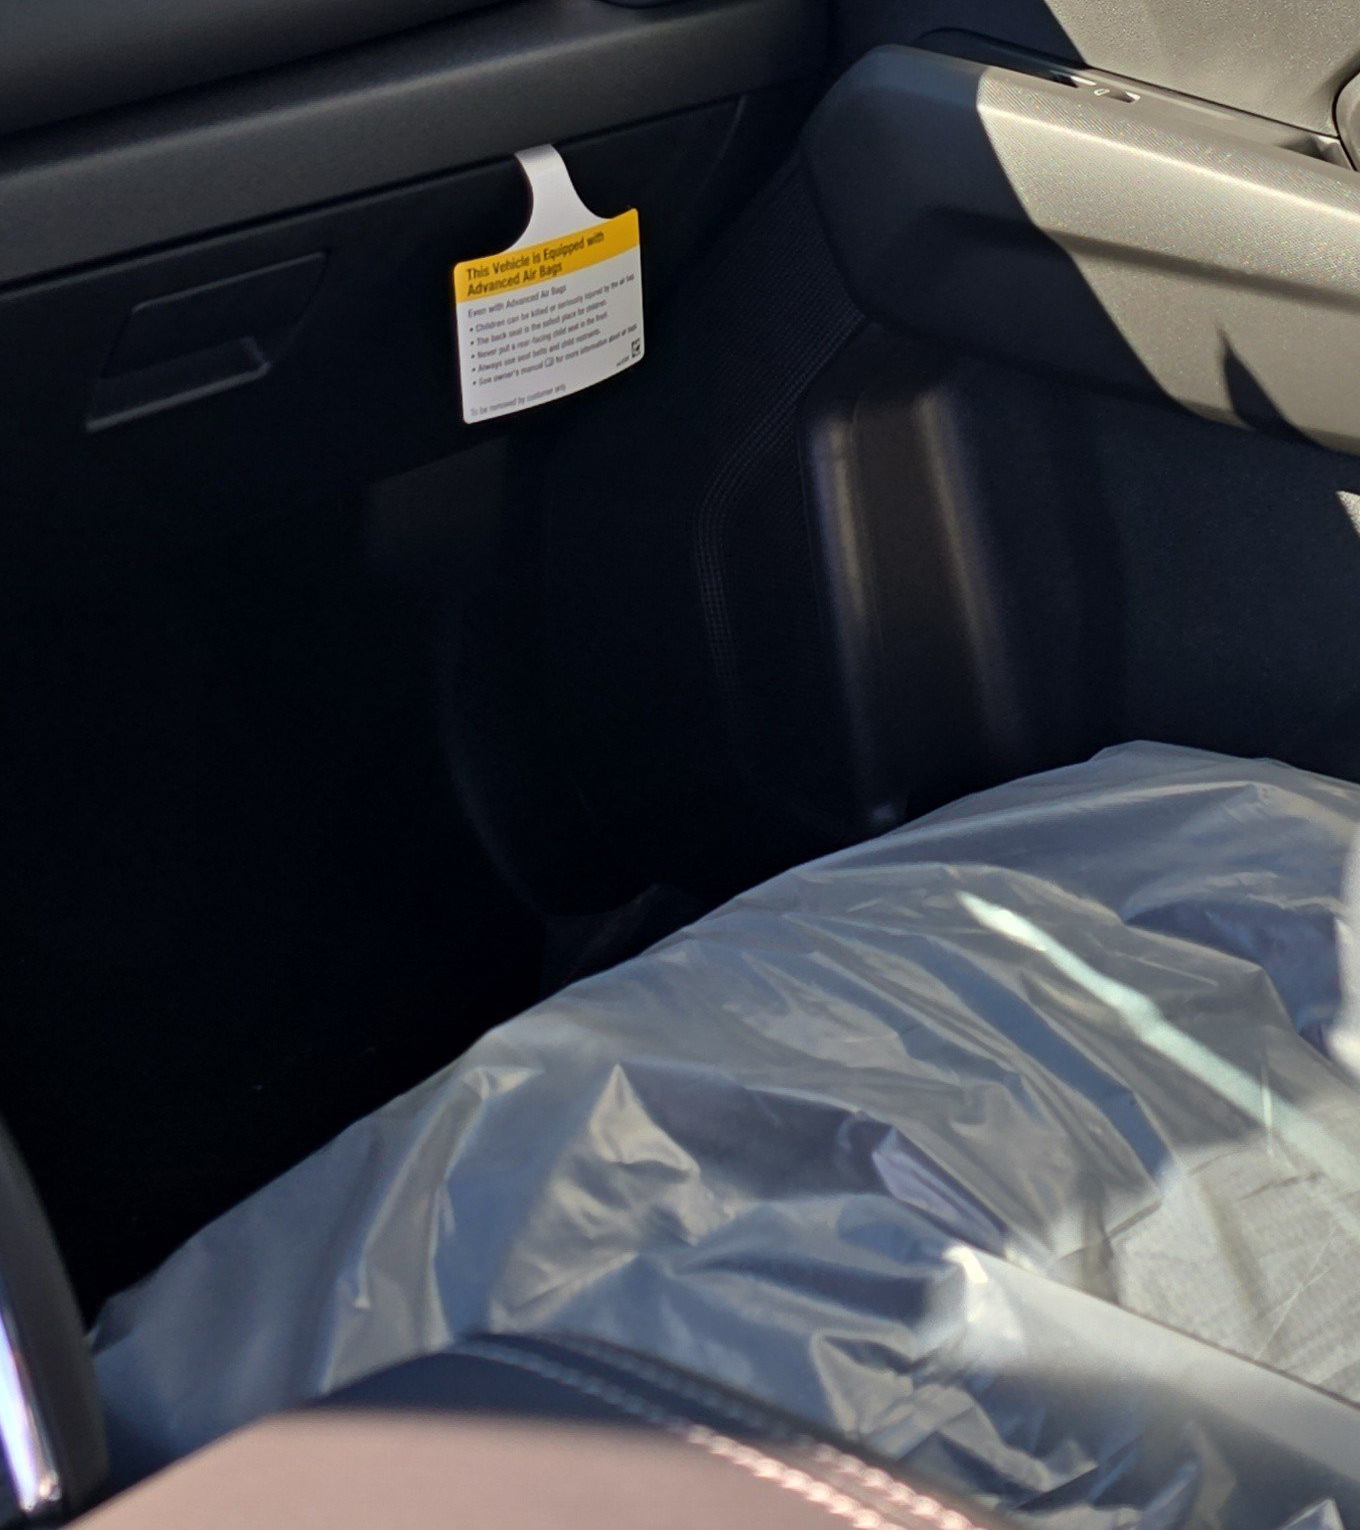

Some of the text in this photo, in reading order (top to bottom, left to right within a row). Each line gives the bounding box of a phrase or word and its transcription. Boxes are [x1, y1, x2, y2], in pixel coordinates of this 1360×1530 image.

[466, 231, 604, 281] This Vehicle is Equipped with
[466, 262, 563, 297] Advanced Air Bags
